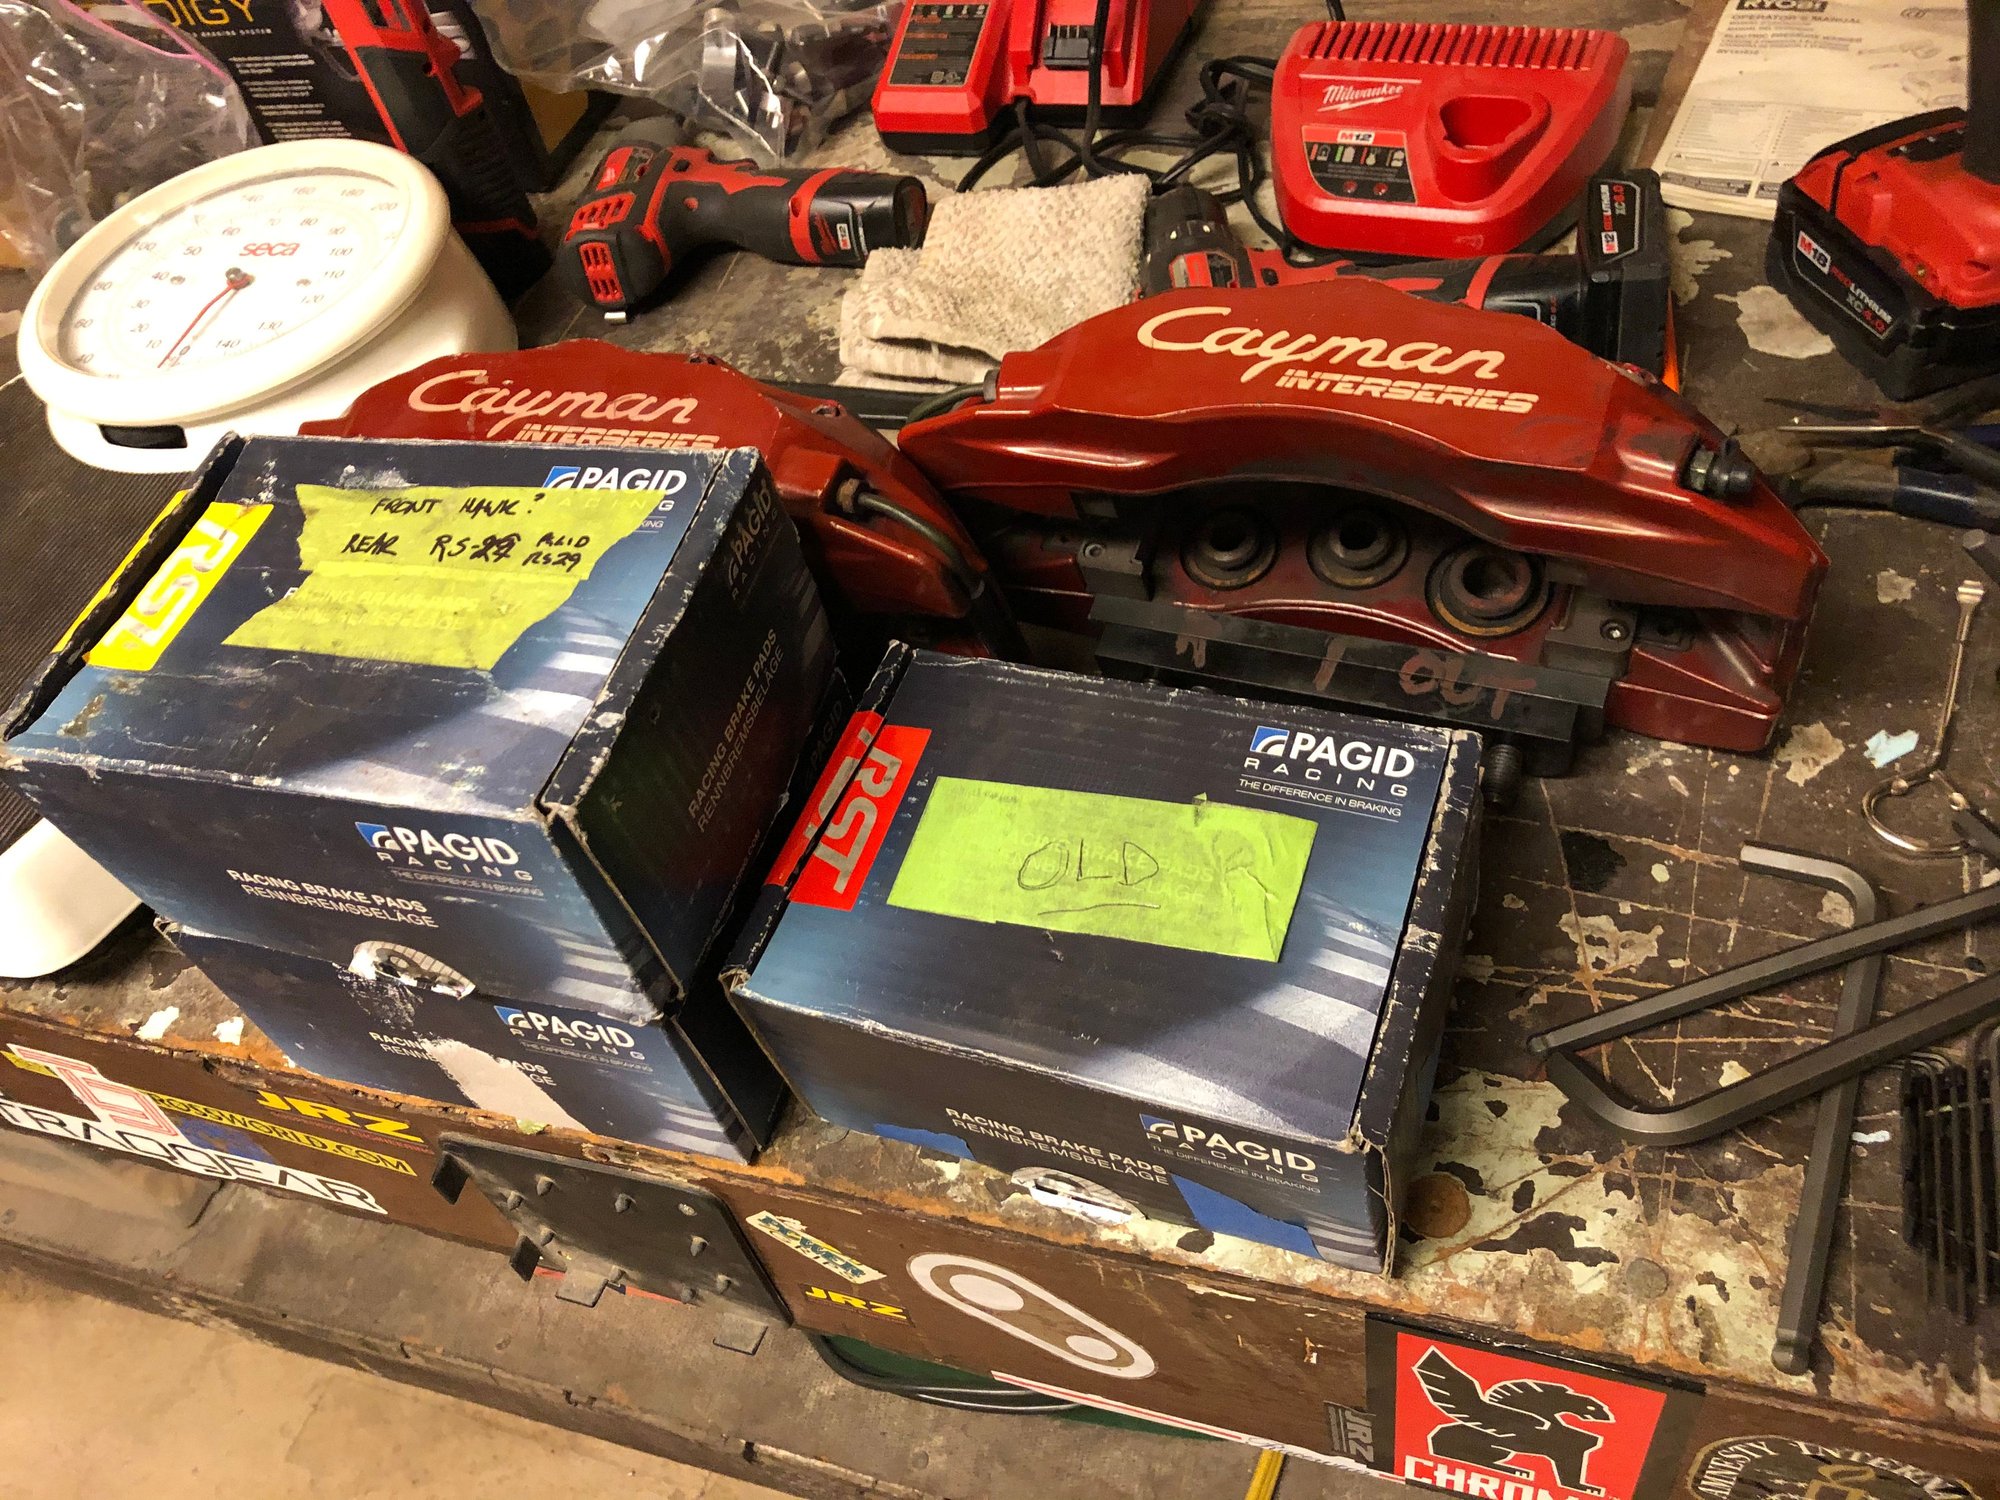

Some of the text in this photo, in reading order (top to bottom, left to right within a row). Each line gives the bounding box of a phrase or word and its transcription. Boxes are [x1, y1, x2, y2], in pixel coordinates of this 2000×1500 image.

[1323, 83, 1403, 105] Milwaukee
[1340, 132, 1373, 142] M12
[239, 241, 301, 257] seca
[1800, 235, 1828, 268] M18
[1136, 306, 1506, 384] Cayman
[408, 369, 699, 438] Cayman
[1275, 368, 1540, 414] INTERSERIES
[576, 467, 688, 496] PAGID
[370, 497, 442, 516] FRONT
[732, 478, 773, 567] PAGID
[341, 534, 400, 556] REAR
[1398, 646, 1537, 720] OUT
[687, 628, 778, 820] RACING BRAKE PADS
[697, 642, 786, 834] RENNBREMSBELÄGE
[1243, 757, 1410, 798] RACING
[1288, 732, 1416, 779] PAGID
[1239, 778, 1402, 817] THE DIFFERENCE IN BRAKING
[376, 851, 534, 882] RACING
[392, 826, 520, 866] PAGID
[1016, 837, 1160, 891] OLD
[226, 868, 429, 914] RACING BRAKE PADS
[240, 884, 440, 929] RENNBREMSBELÄGE
[368, 1031, 430, 1053] RACIN
[508, 1028, 646, 1061] RACING
[527, 1011, 636, 1049] PAGID
[512, 1060, 549, 1075] ADS
[256, 1090, 425, 1143] JRZ
[945, 1107, 1168, 1175] RACING BRAKE PADS
[952, 1118, 1171, 1187] RENNBREMSBELÄGE
[1146, 1132, 1320, 1184] RACING
[1182, 1124, 1317, 1173] PAGID
[1152, 1145, 1321, 1195] THE DIFFERENCE IN BRAKING
[805, 1286, 907, 1320] JRZ
[1345, 1410, 1375, 1463] JRZ
[1698, 1440, 1781, 1500] AMNESTY
